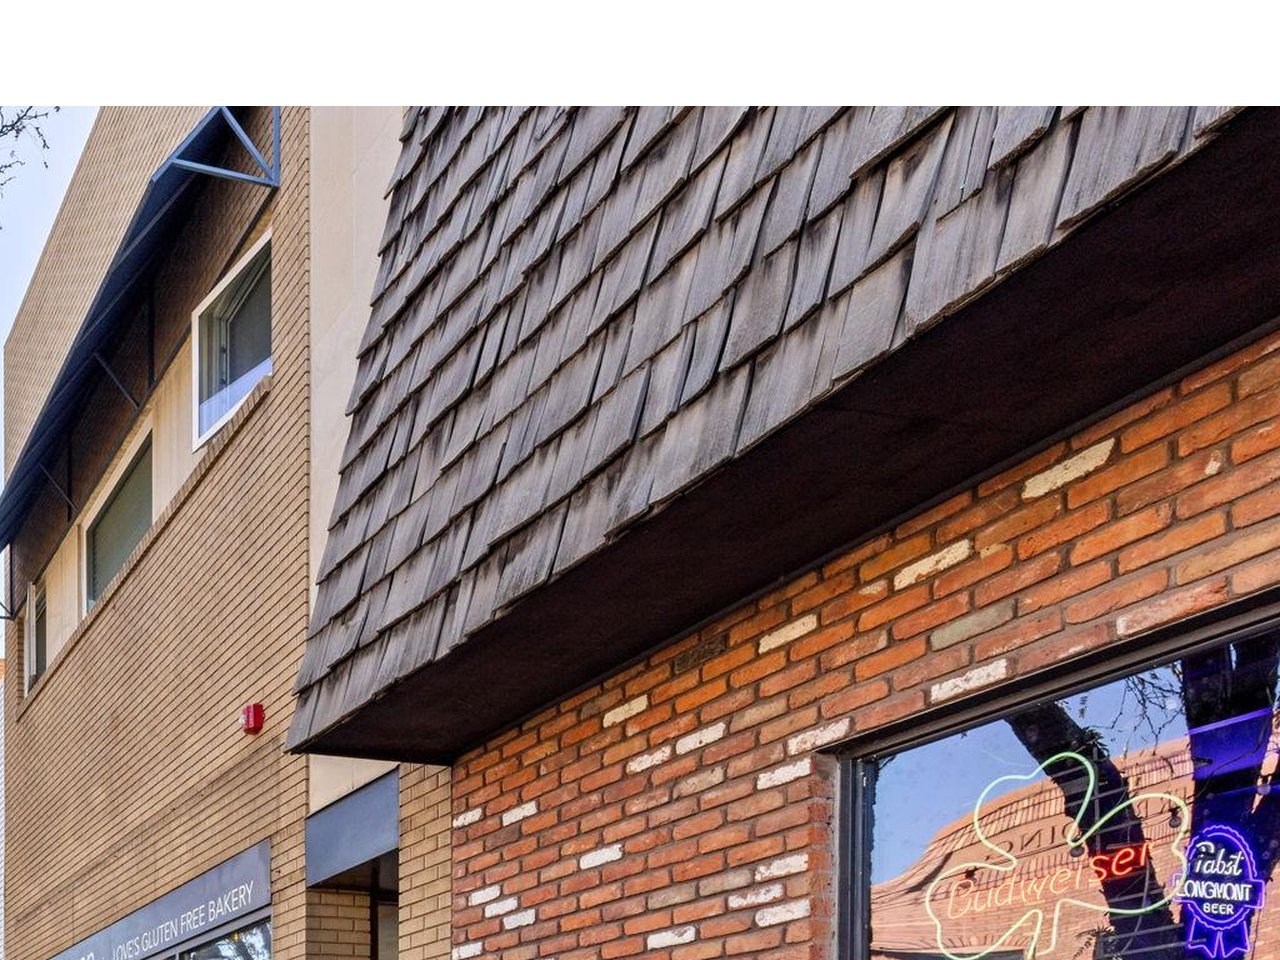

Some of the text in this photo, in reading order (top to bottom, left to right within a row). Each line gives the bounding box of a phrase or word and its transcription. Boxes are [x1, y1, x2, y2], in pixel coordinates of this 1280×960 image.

[1194, 841, 1245, 876] Pabst
[947, 842, 1158, 919] Budweiser
[1176, 879, 1252, 901] LONGMONT
[141, 920, 179, 951] GLUTEN
[180, 905, 206, 933] FREE
[208, 880, 254, 922] BAKERY
[1203, 902, 1234, 915] BEER
